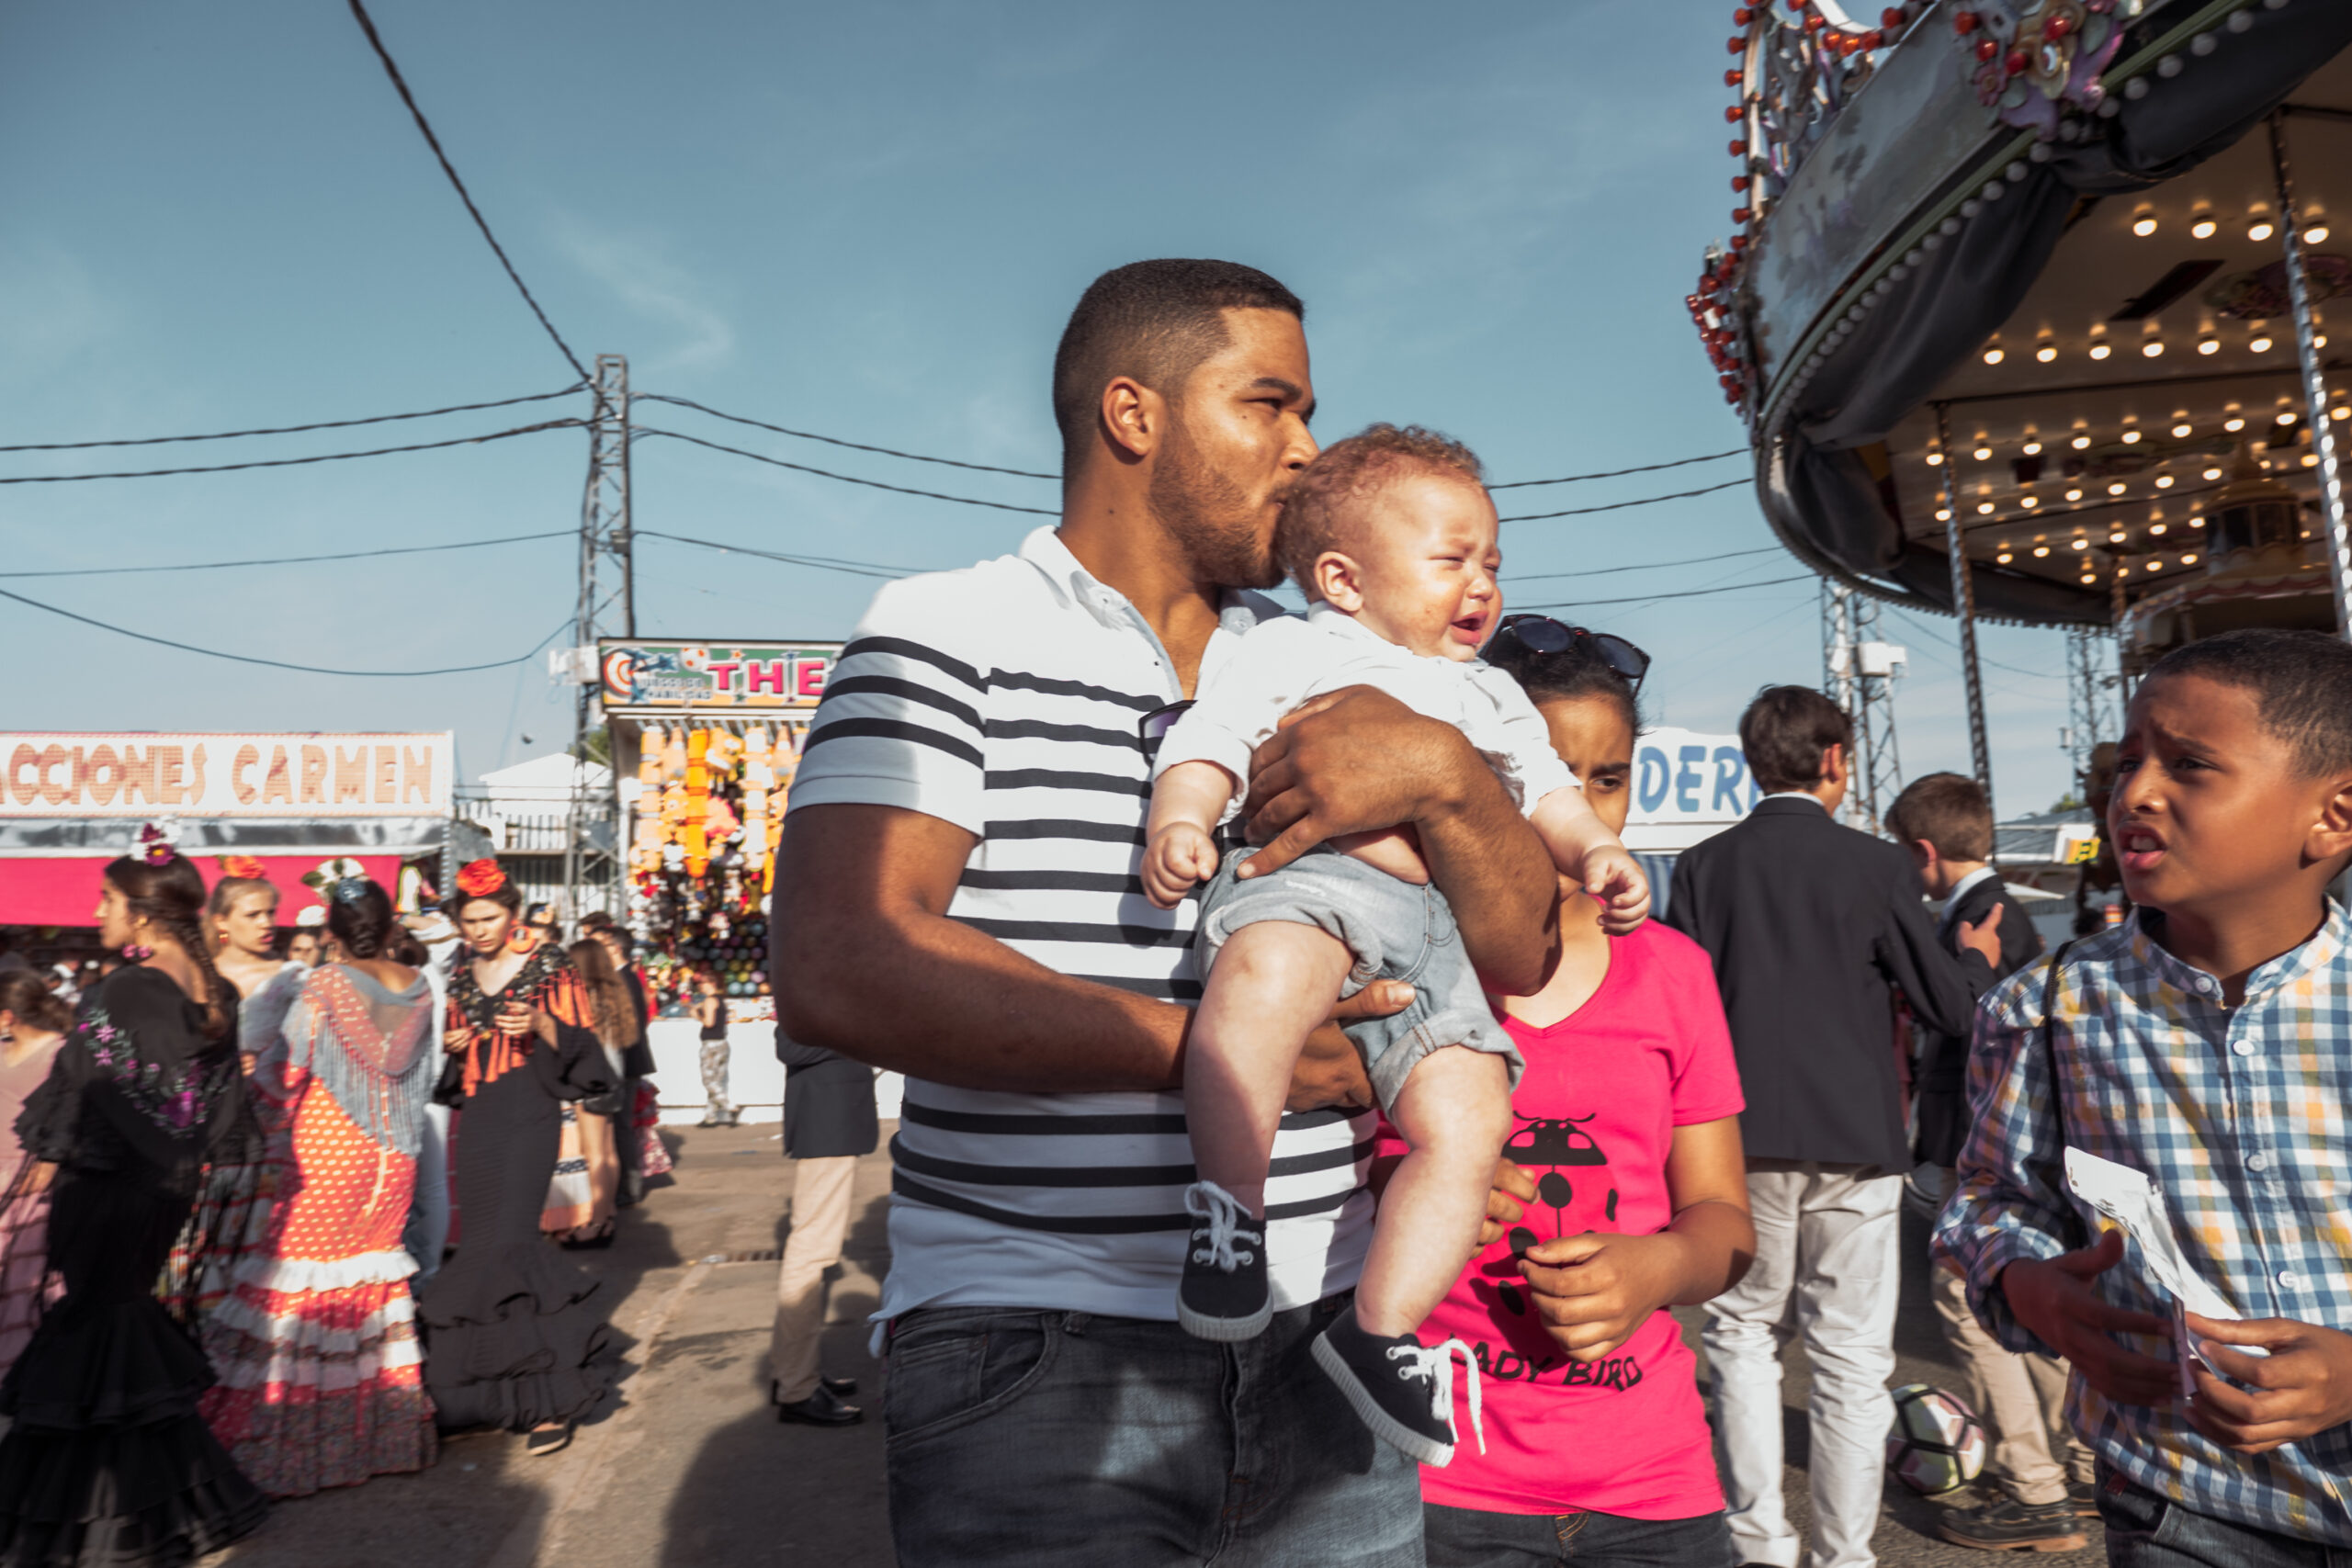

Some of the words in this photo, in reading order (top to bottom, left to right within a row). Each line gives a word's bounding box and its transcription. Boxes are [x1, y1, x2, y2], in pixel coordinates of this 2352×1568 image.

[0, 742, 207, 806] CCIONES
[232, 743, 433, 805] CARMEN
[1562, 1355, 1643, 1392] BIRD
